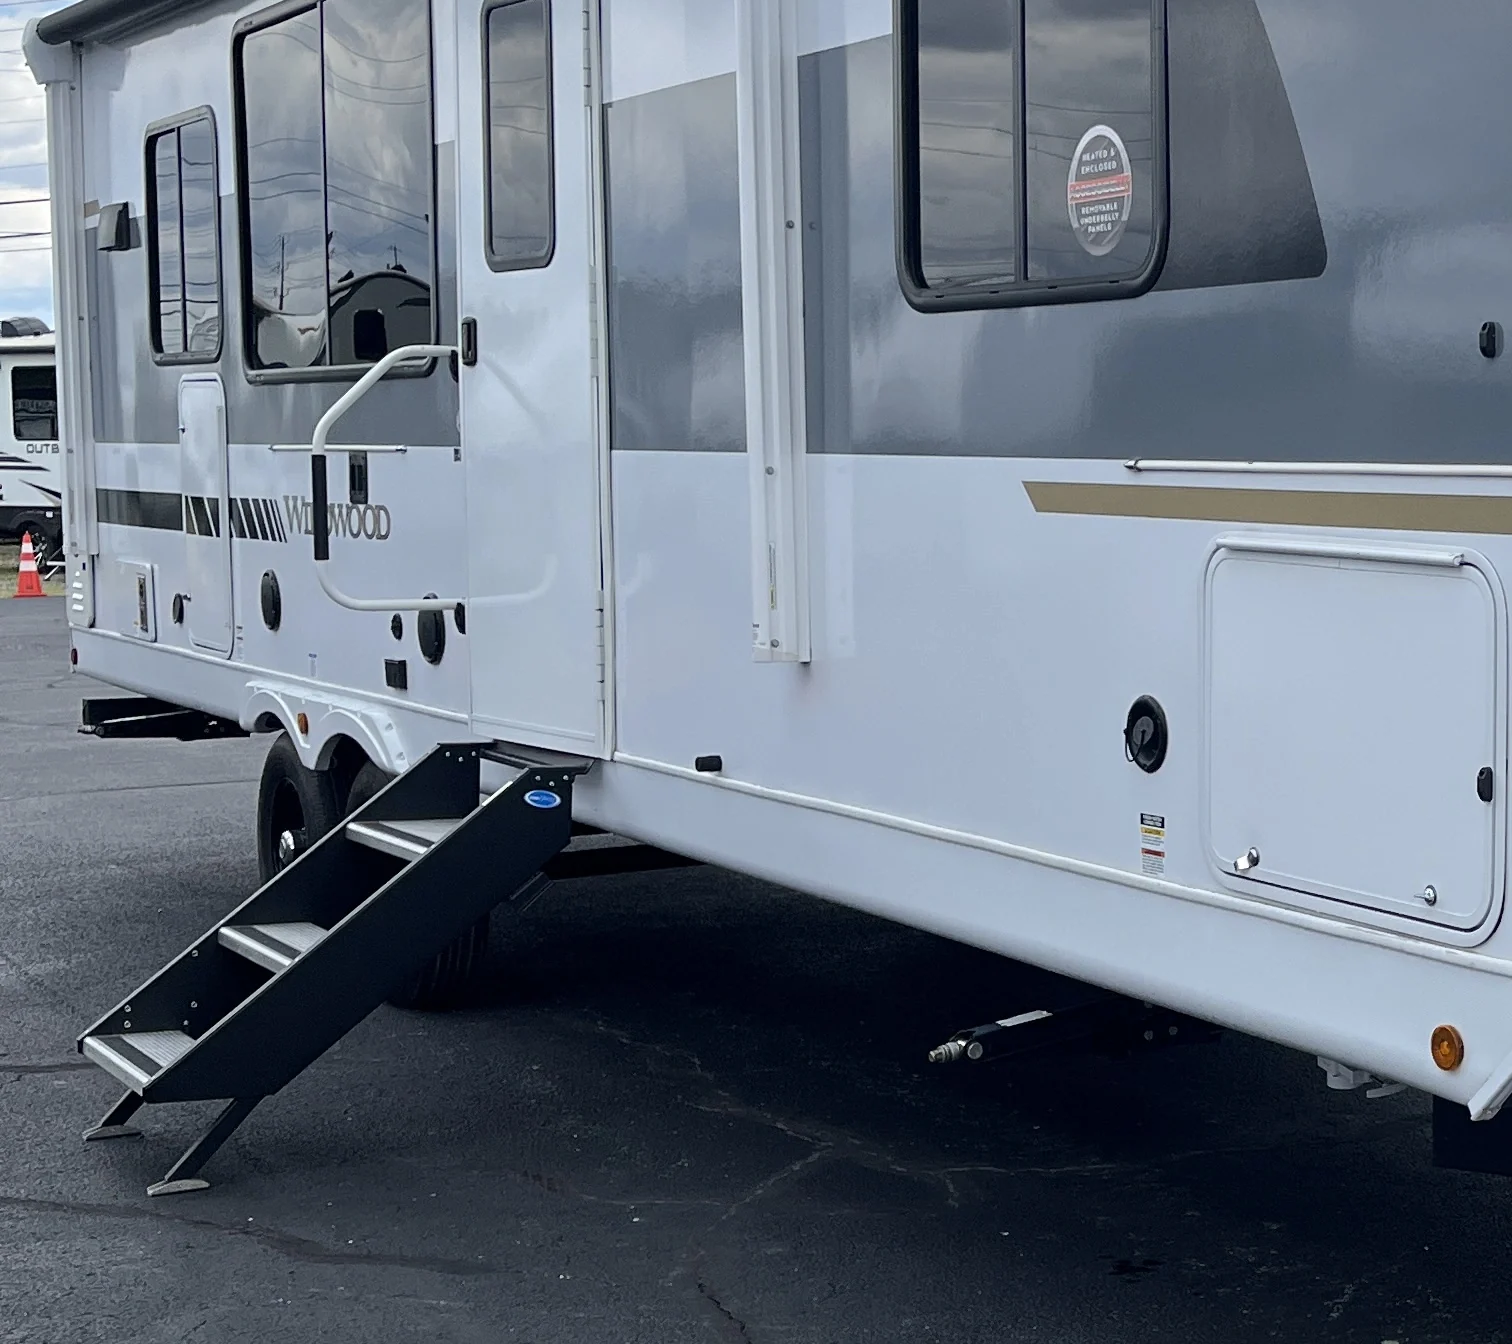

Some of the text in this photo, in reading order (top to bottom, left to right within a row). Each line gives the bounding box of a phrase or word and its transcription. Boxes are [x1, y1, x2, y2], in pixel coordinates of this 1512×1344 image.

[1081, 149, 1108, 161] HEATED
[1080, 160, 1117, 175] ENCLOSED
[283, 495, 391, 541] WIWOOD
